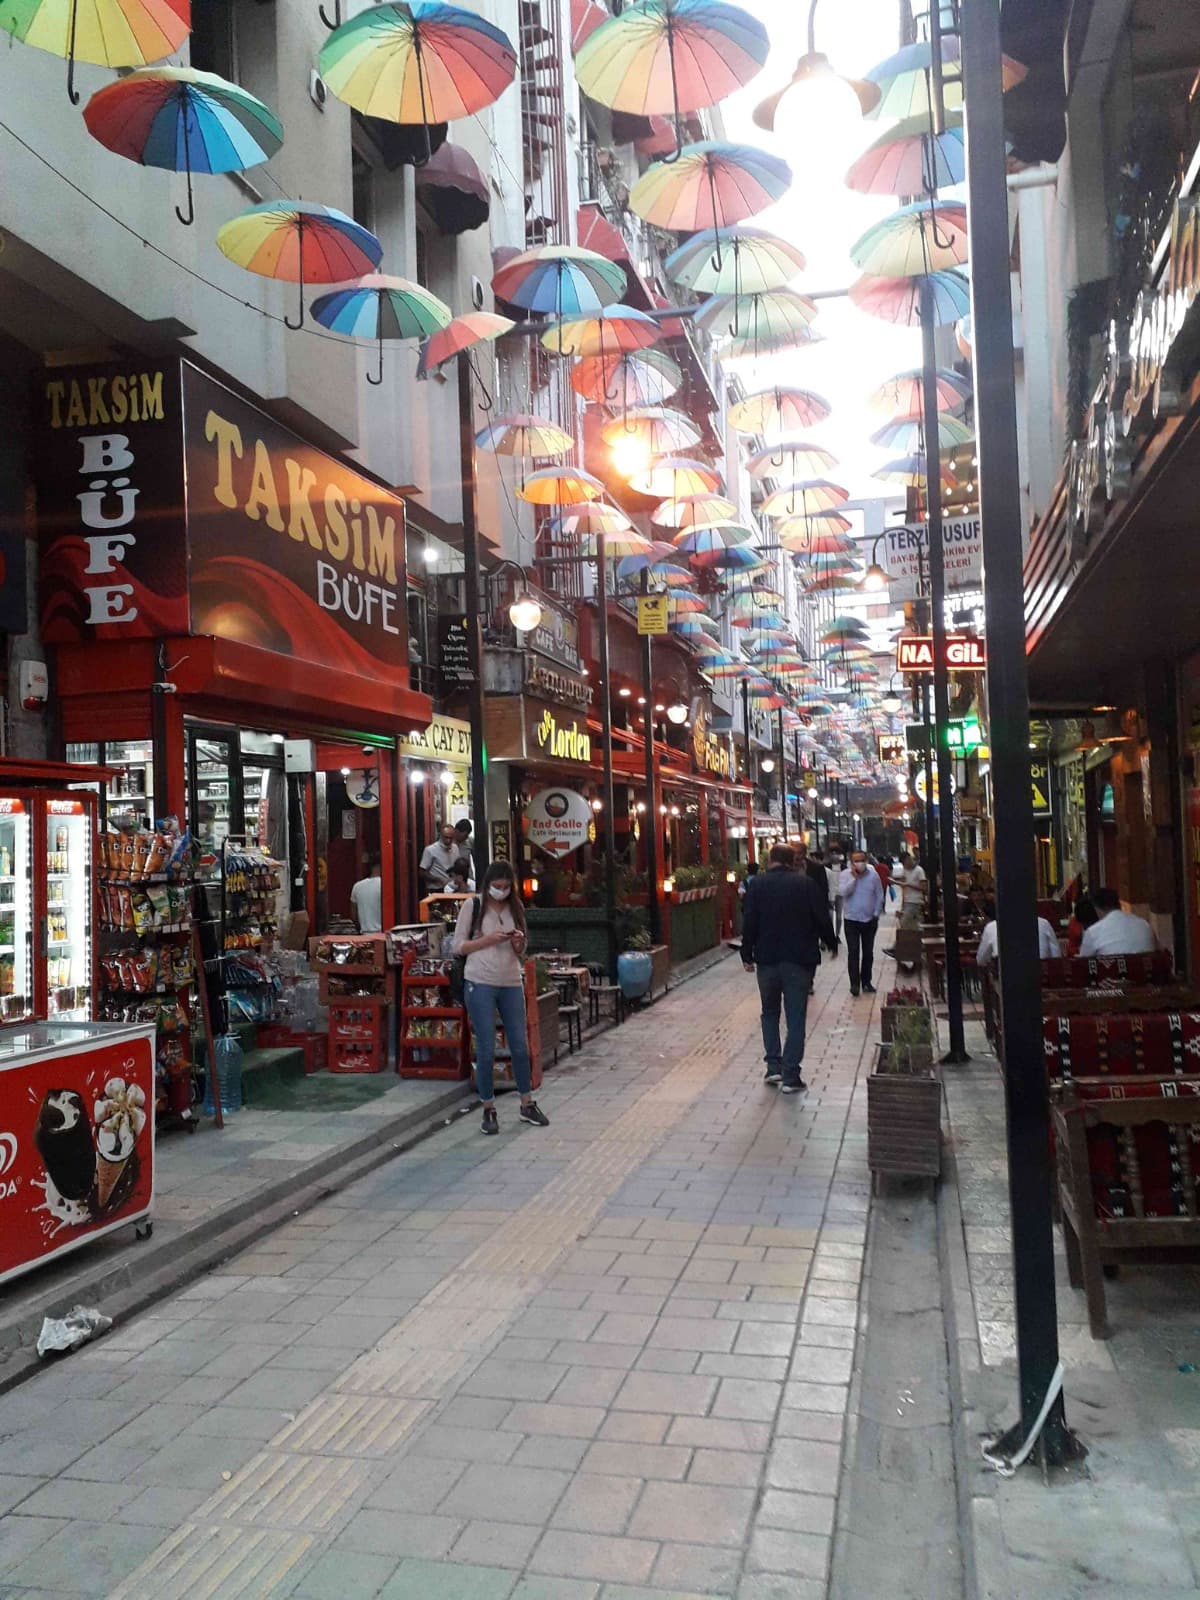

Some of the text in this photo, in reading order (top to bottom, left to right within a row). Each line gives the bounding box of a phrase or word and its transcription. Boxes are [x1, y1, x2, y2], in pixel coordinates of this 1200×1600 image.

[943, 520, 981, 543] USUF
[316, 559, 400, 635] BÜFE
[432, 723, 455, 756] ÇAY
[550, 718, 591, 762] Lorden
[532, 818, 582, 829] End Gallo
